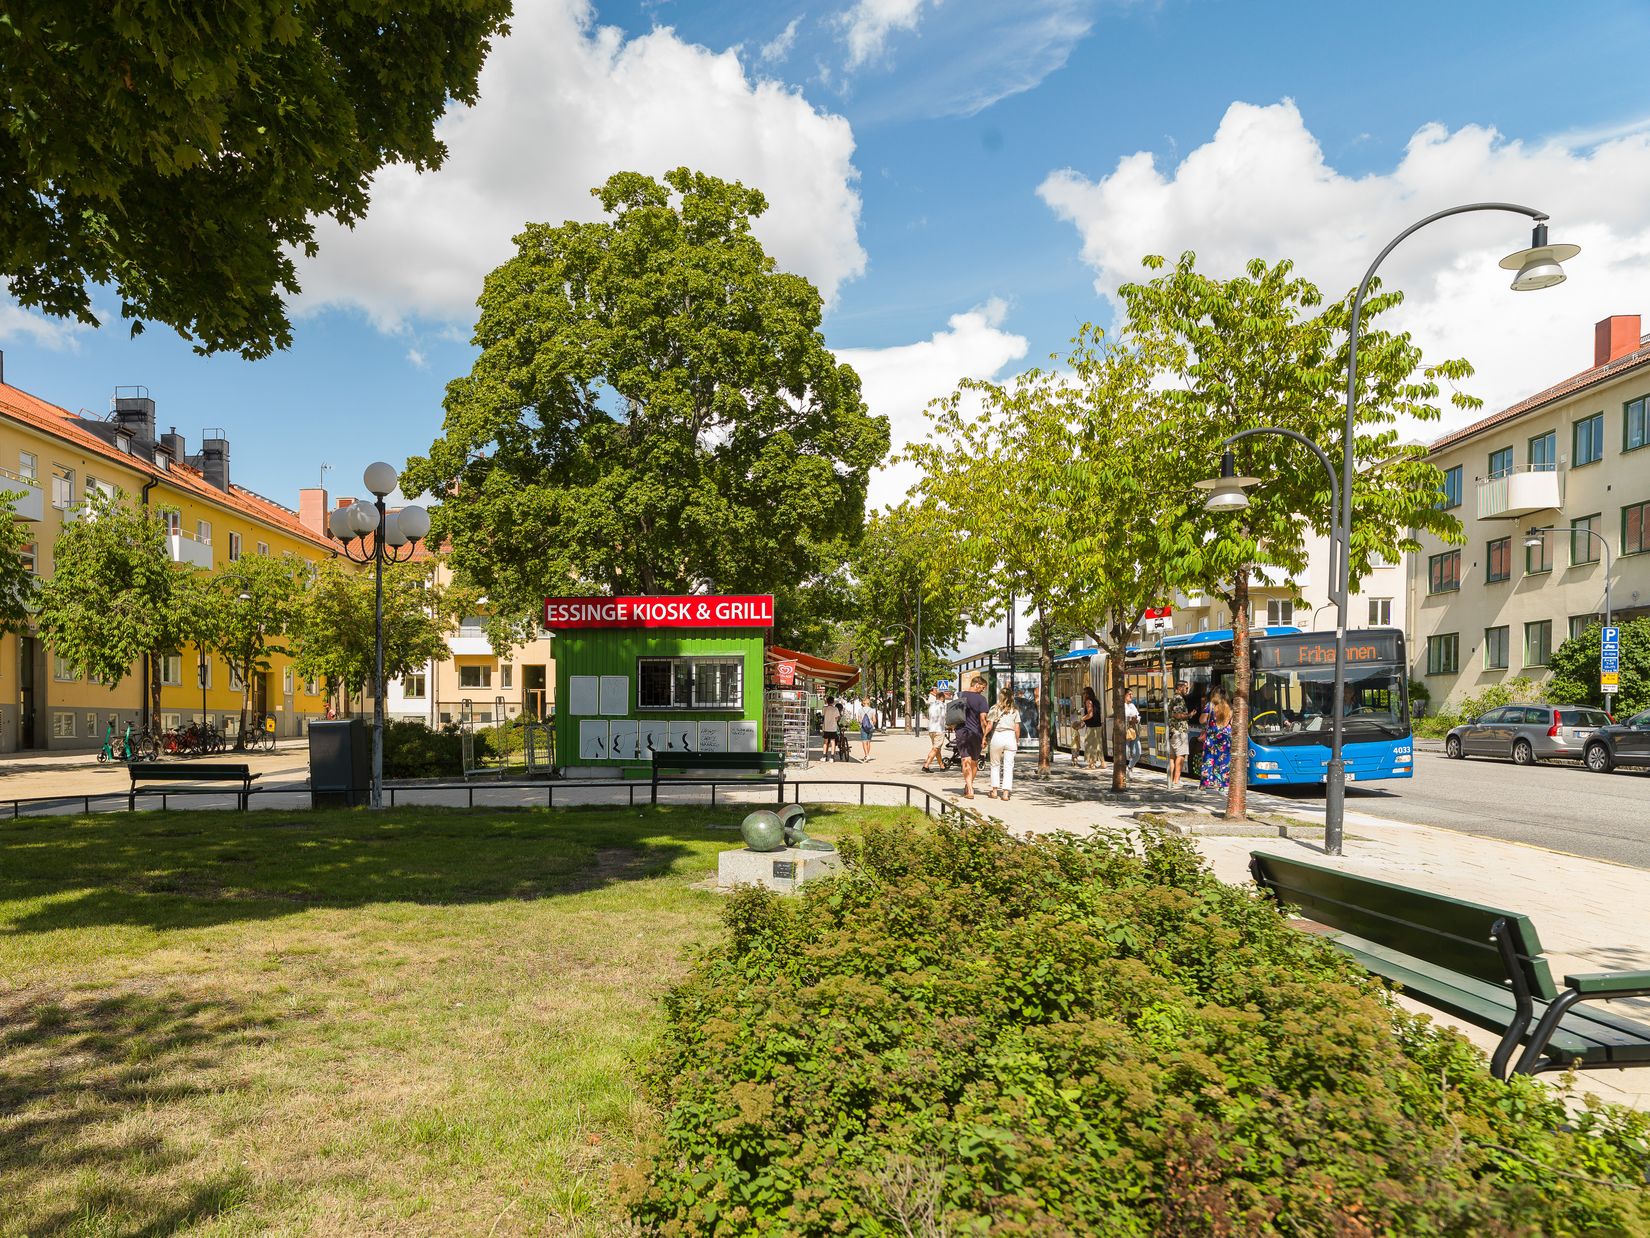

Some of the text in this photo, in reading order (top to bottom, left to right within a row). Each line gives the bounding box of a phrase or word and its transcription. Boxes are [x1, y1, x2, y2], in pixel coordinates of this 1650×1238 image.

[547, 602, 772, 621] ESSINGE KIOSK & GRILL
[1606, 629, 1616, 641] P
[1274, 644, 1377, 665] 1 Frihanen
[1392, 746, 1411, 754] 4033
